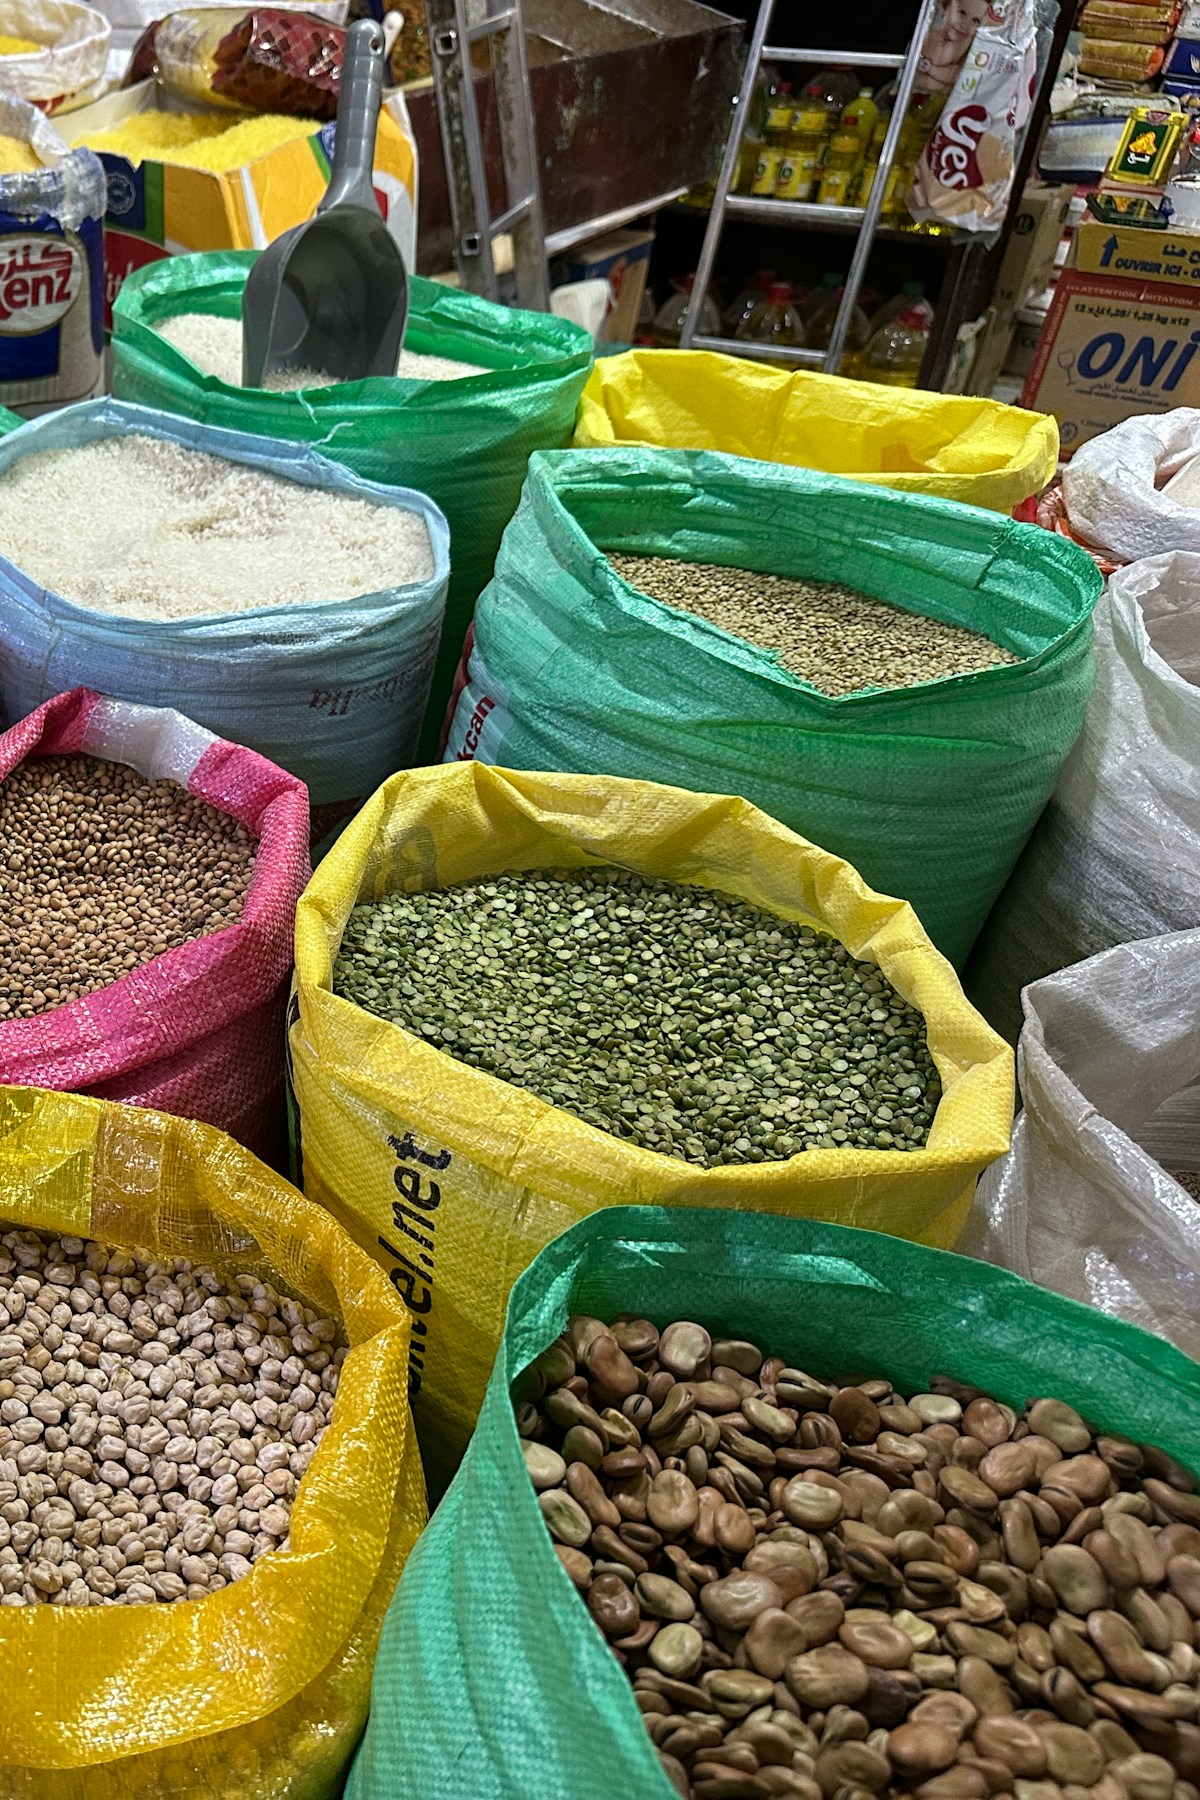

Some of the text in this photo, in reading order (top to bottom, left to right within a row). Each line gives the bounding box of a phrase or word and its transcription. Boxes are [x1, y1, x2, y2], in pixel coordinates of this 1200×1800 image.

[3, 243, 73, 281] كنز
[1115, 257, 1162, 275] OUVRIR
[1080, 285, 1137, 299] ATTENTION
